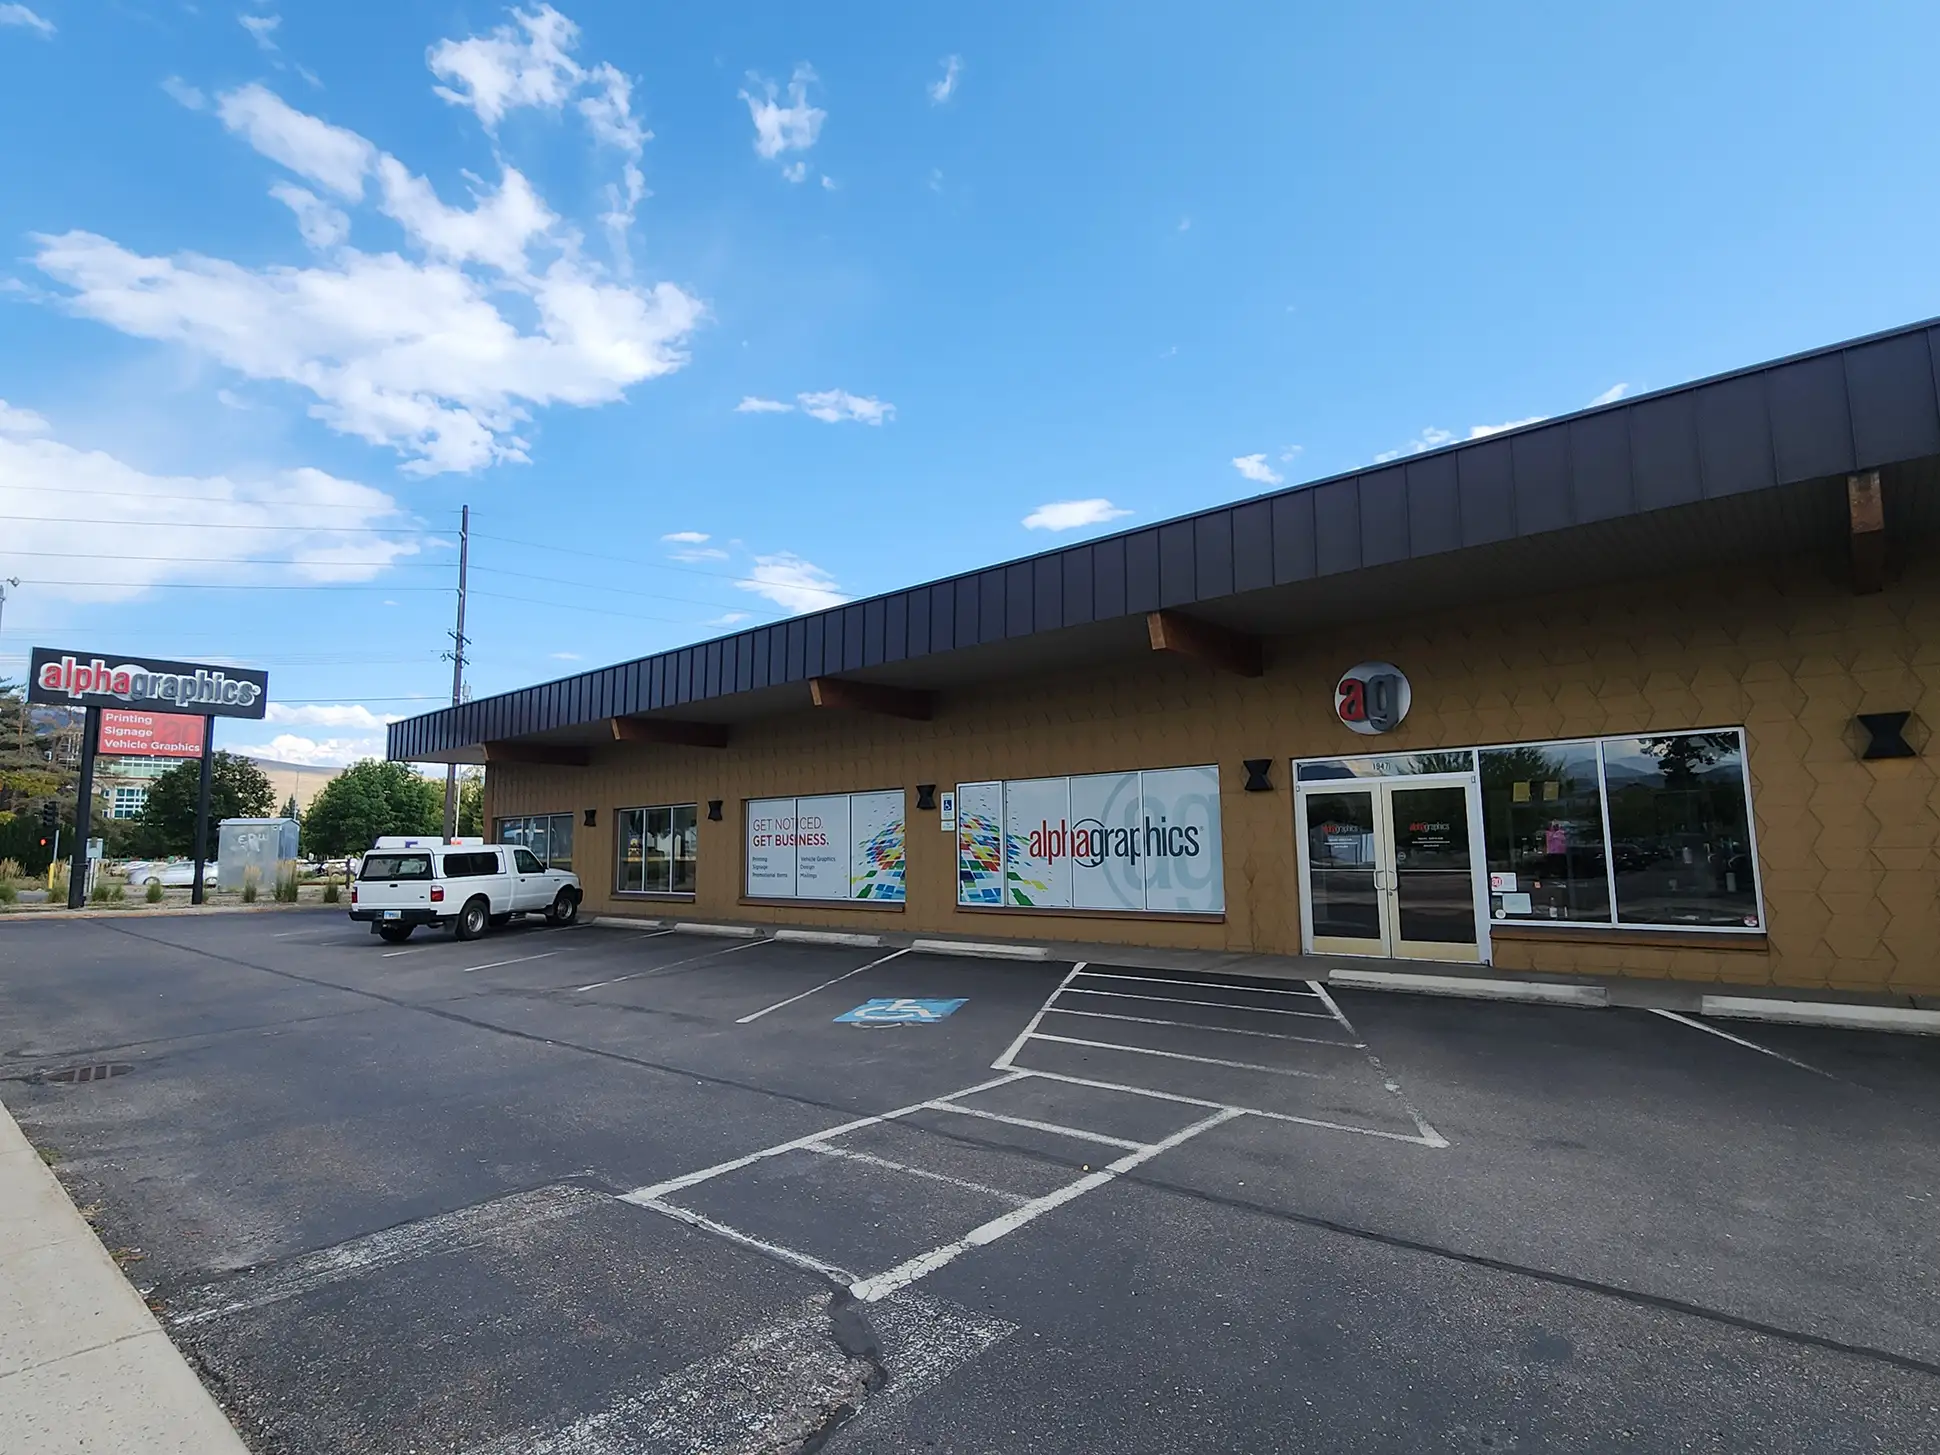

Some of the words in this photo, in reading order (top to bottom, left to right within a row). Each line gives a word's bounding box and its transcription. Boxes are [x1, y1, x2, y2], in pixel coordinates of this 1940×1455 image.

[39, 656, 257, 707] alphagraphics
[1339, 674, 1398, 731] ag
[105, 713, 153, 725] Printing
[104, 726, 153, 737] Signage
[104, 739, 147, 749] Vehicle
[150, 741, 201, 752] Graphics
[752, 819, 773, 832] GET
[752, 835, 773, 847] GET
[775, 833, 830, 846] BUSINESS.
[1029, 816, 1201, 867] alphagraphics
[816, 855, 836, 863] Graphics
